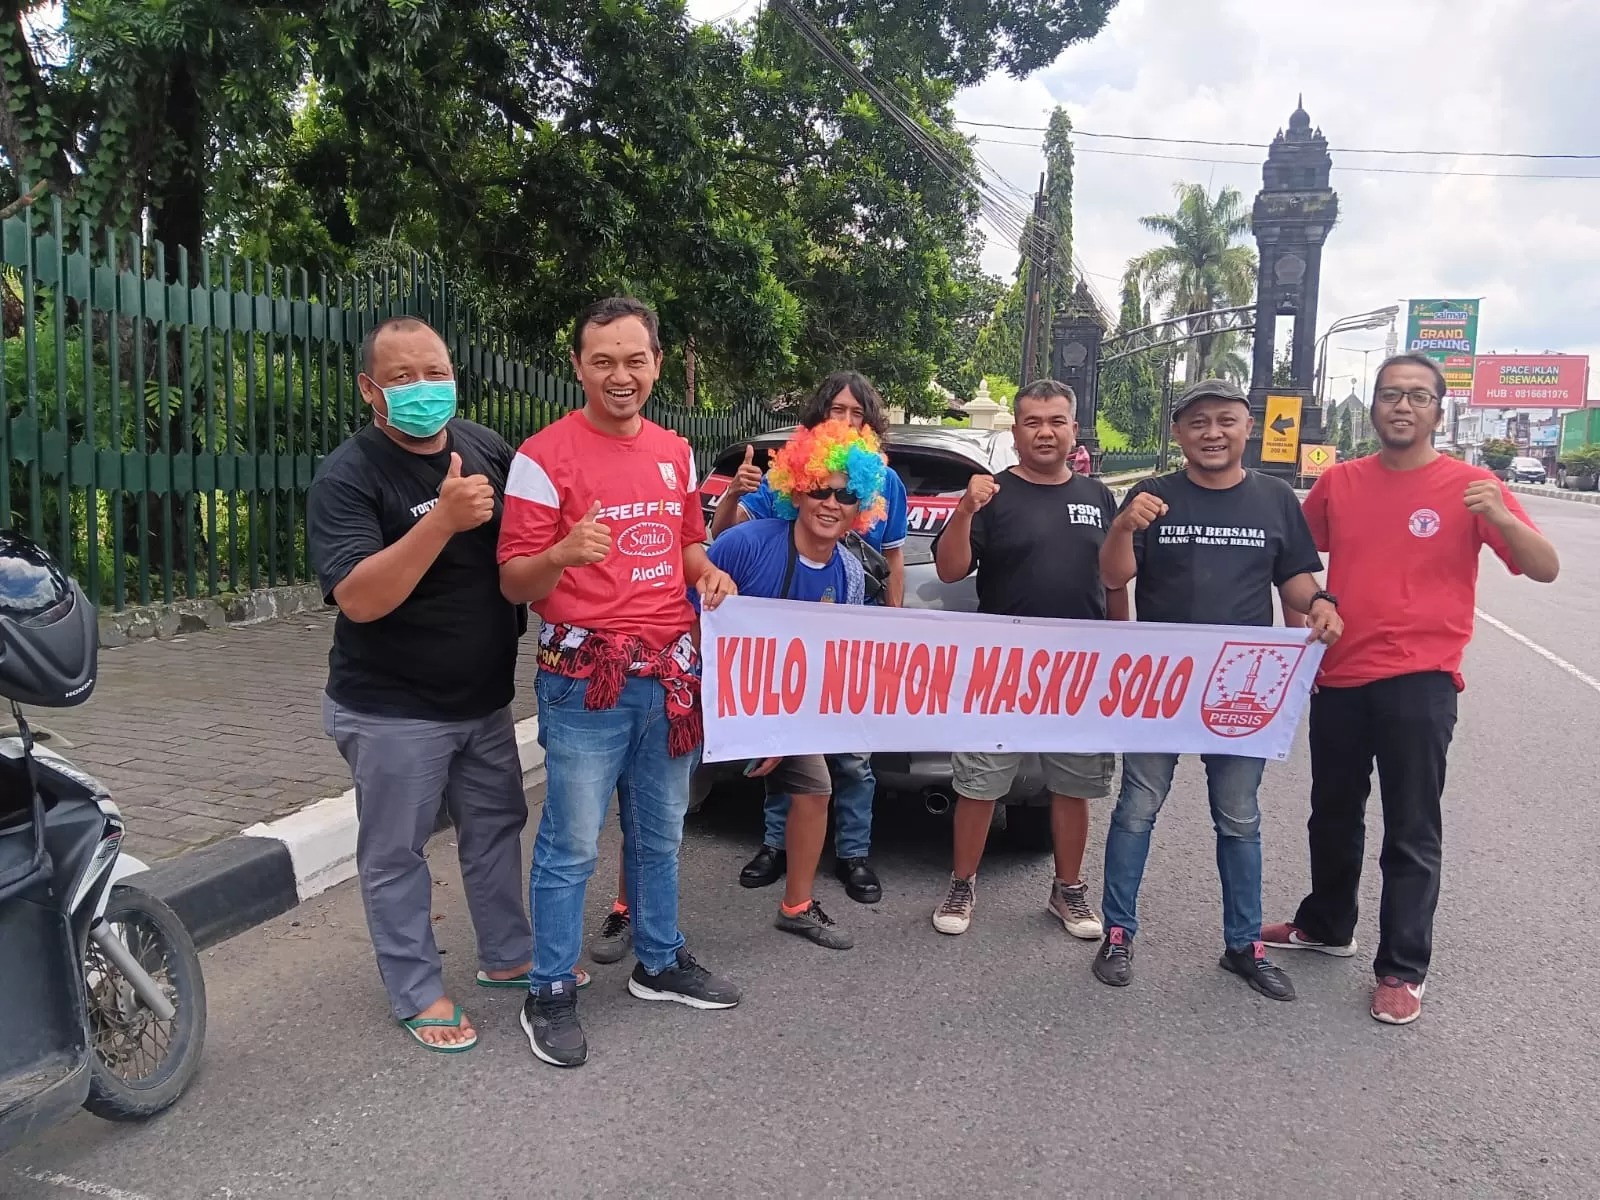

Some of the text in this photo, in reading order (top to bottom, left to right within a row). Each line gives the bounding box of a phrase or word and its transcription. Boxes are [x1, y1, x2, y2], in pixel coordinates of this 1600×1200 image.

[1420, 328, 1463, 339] GRAND
[1411, 339, 1470, 351] OPENING
[1500, 366, 1559, 375] SPACE IKLAN
[1499, 375, 1558, 385] DISEWAKAN
[1487, 389, 1507, 398] HUB
[410, 498, 439, 517] YOGY
[1067, 504, 1101, 518] PSIM
[1070, 514, 1097, 526] LIGA
[630, 530, 665, 547] Sania
[1160, 525, 1265, 539] TUHAN BERSAMA
[1159, 536, 1189, 544] ORANG
[1195, 537, 1228, 545] ORANG
[1230, 538, 1265, 548] BERANI
[631, 561, 672, 583] Aladin
[716, 636, 1195, 720] KULO NUWON MASKU SOLO
[65, 679, 93, 698] HONDA
[1209, 712, 1263, 725] PERSIS
